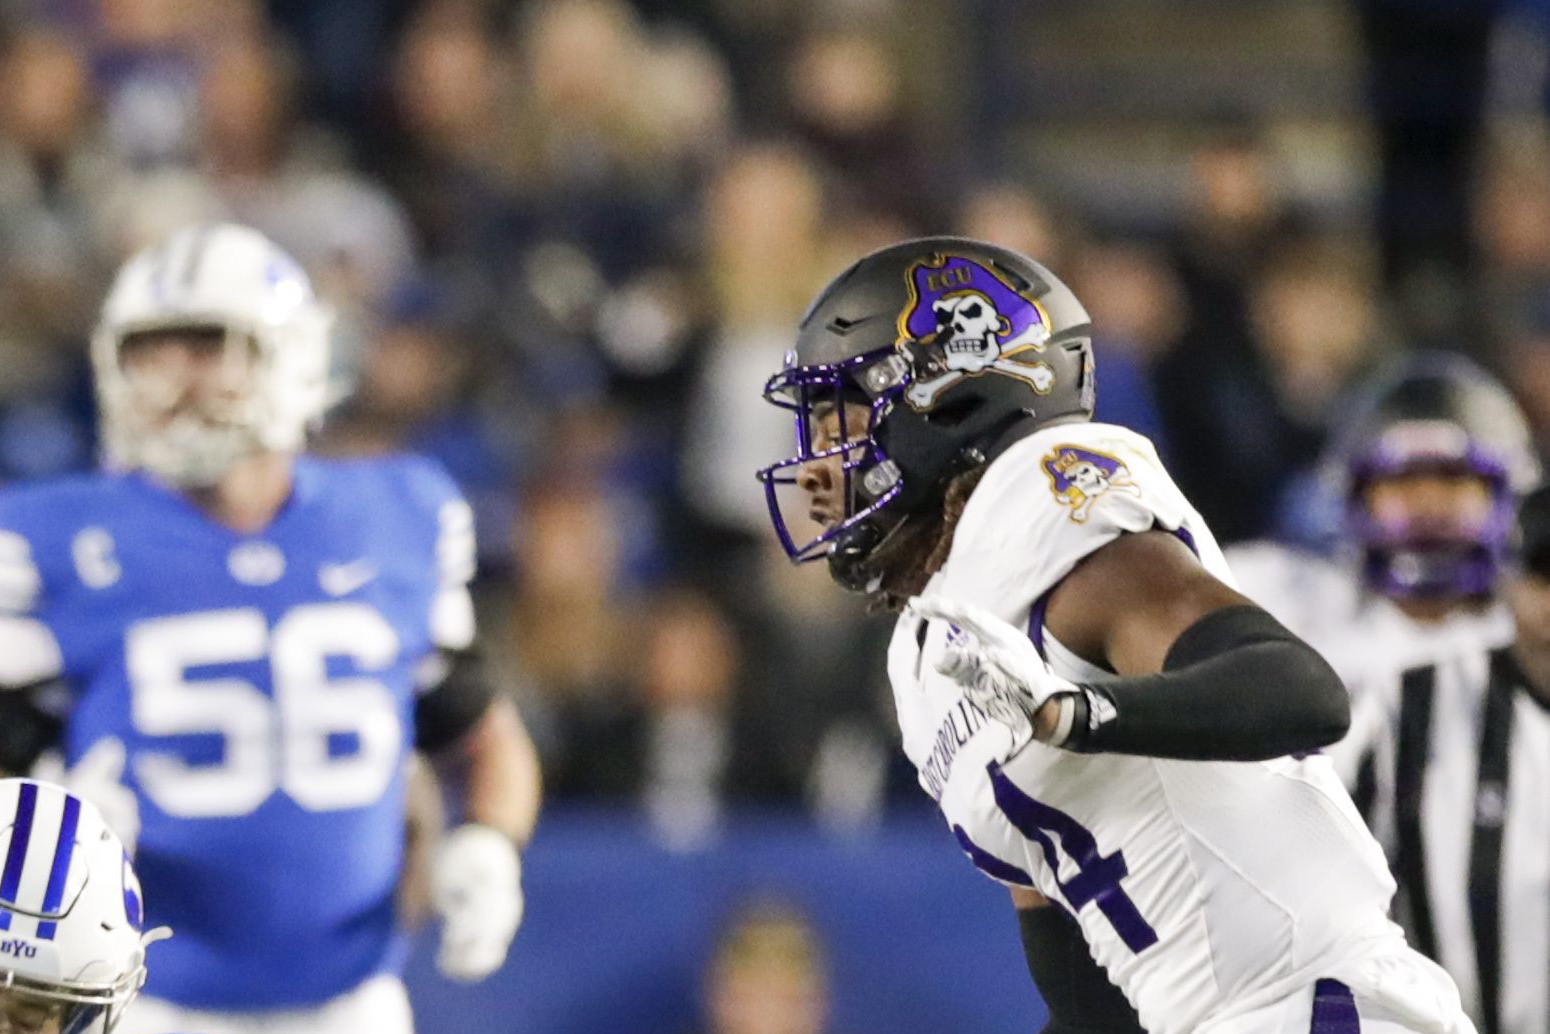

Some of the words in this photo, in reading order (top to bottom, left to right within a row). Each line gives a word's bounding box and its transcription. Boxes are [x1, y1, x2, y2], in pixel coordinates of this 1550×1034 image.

[926, 266, 974, 292] ECU
[1052, 450, 1078, 473] ECU
[125, 602, 399, 818] 56
[933, 694, 990, 783] CAROLIN
[0, 940, 38, 958] BYU
